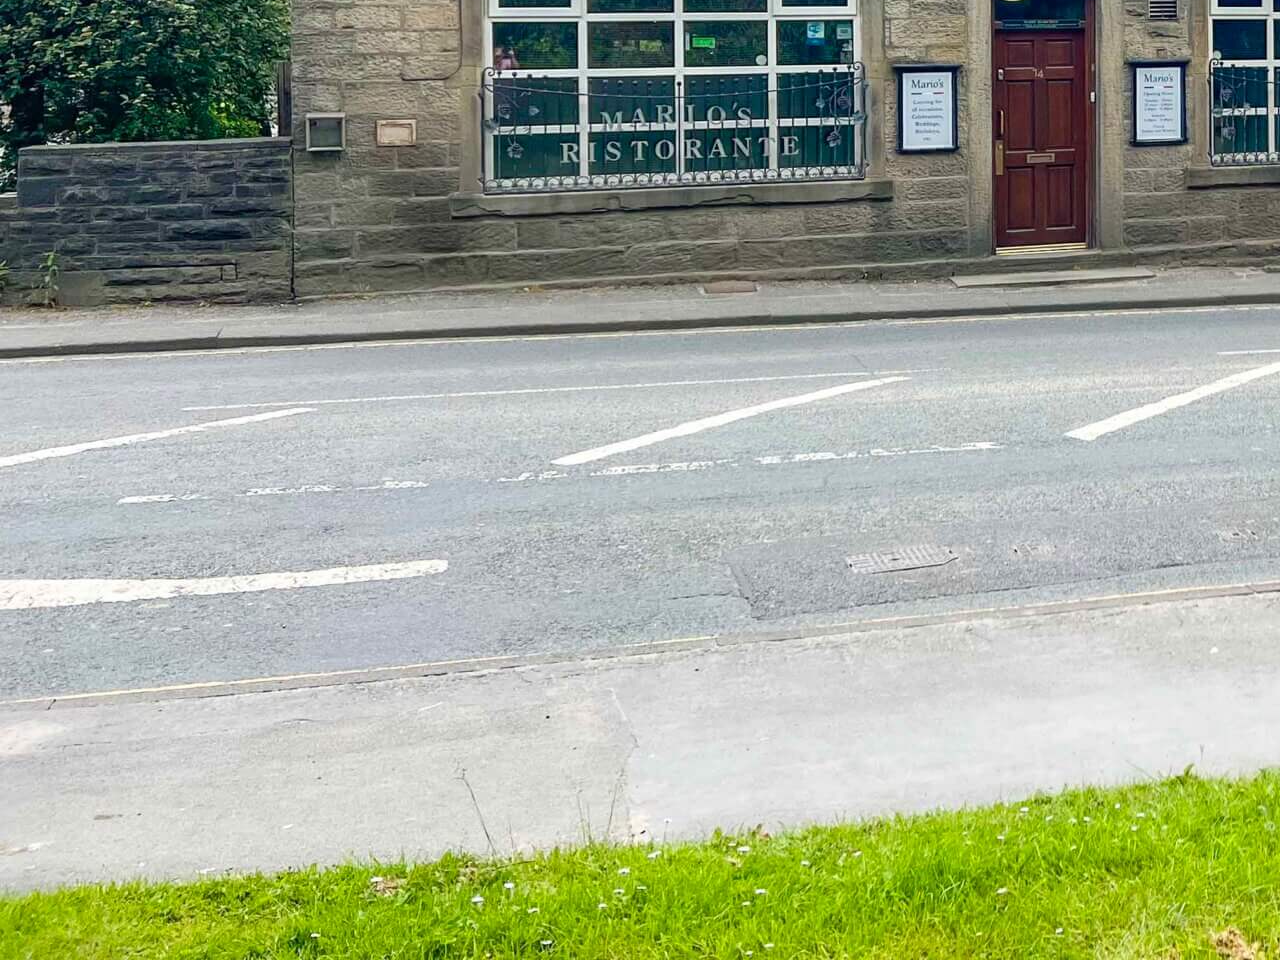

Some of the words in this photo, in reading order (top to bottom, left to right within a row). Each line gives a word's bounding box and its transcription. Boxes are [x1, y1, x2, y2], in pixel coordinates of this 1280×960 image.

[911, 79, 944, 89] Mario's
[1143, 73, 1174, 83] Mario's
[600, 102, 752, 132] MARIO'S
[559, 135, 800, 164] RISTORANTE
